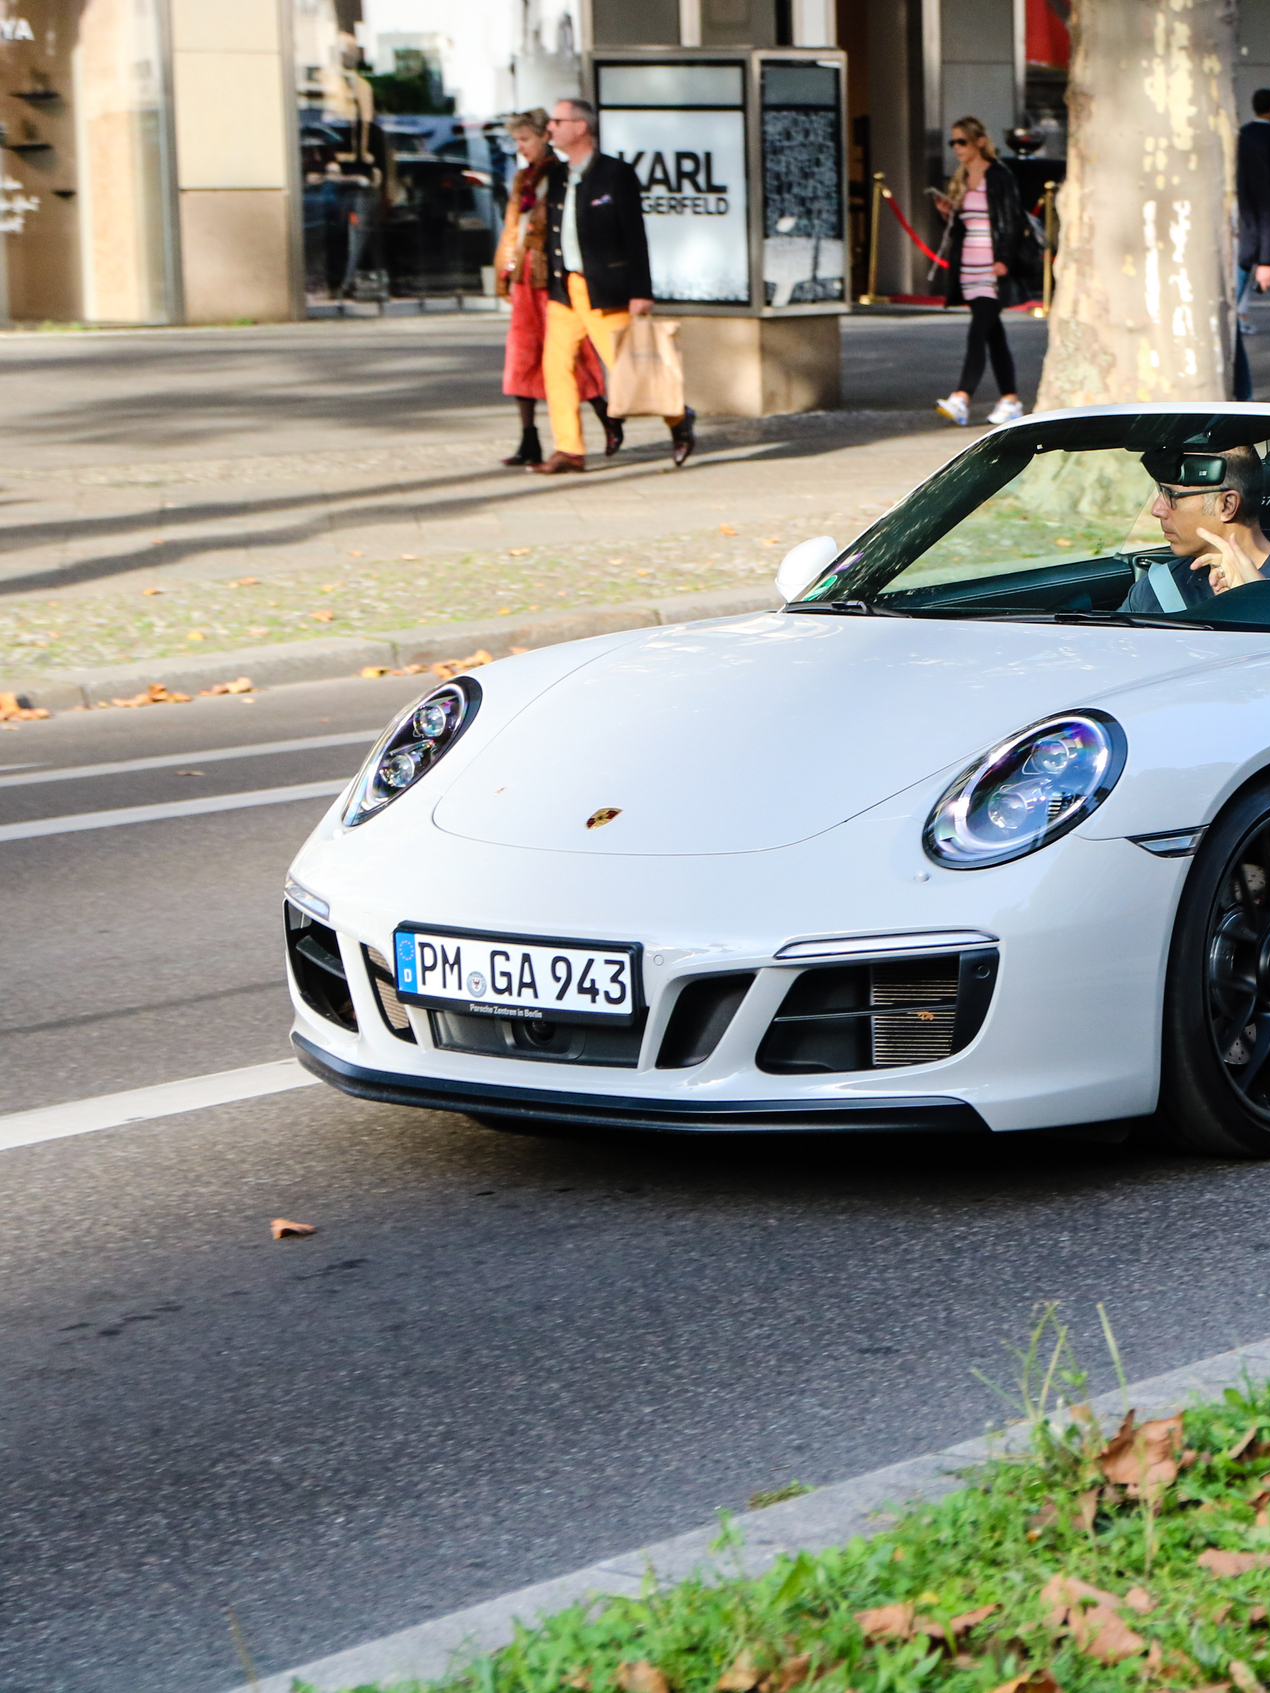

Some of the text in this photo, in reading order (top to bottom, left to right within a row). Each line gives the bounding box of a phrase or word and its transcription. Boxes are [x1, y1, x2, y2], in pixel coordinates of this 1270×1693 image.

[640, 196, 729, 215] GERFELD
[403, 968, 413, 983] D
[418, 941, 627, 1005] PM GA 943
[469, 1003, 493, 1014] Porsche
[517, 1008, 524, 1017] in
[524, 1008, 543, 1019] Berlin
